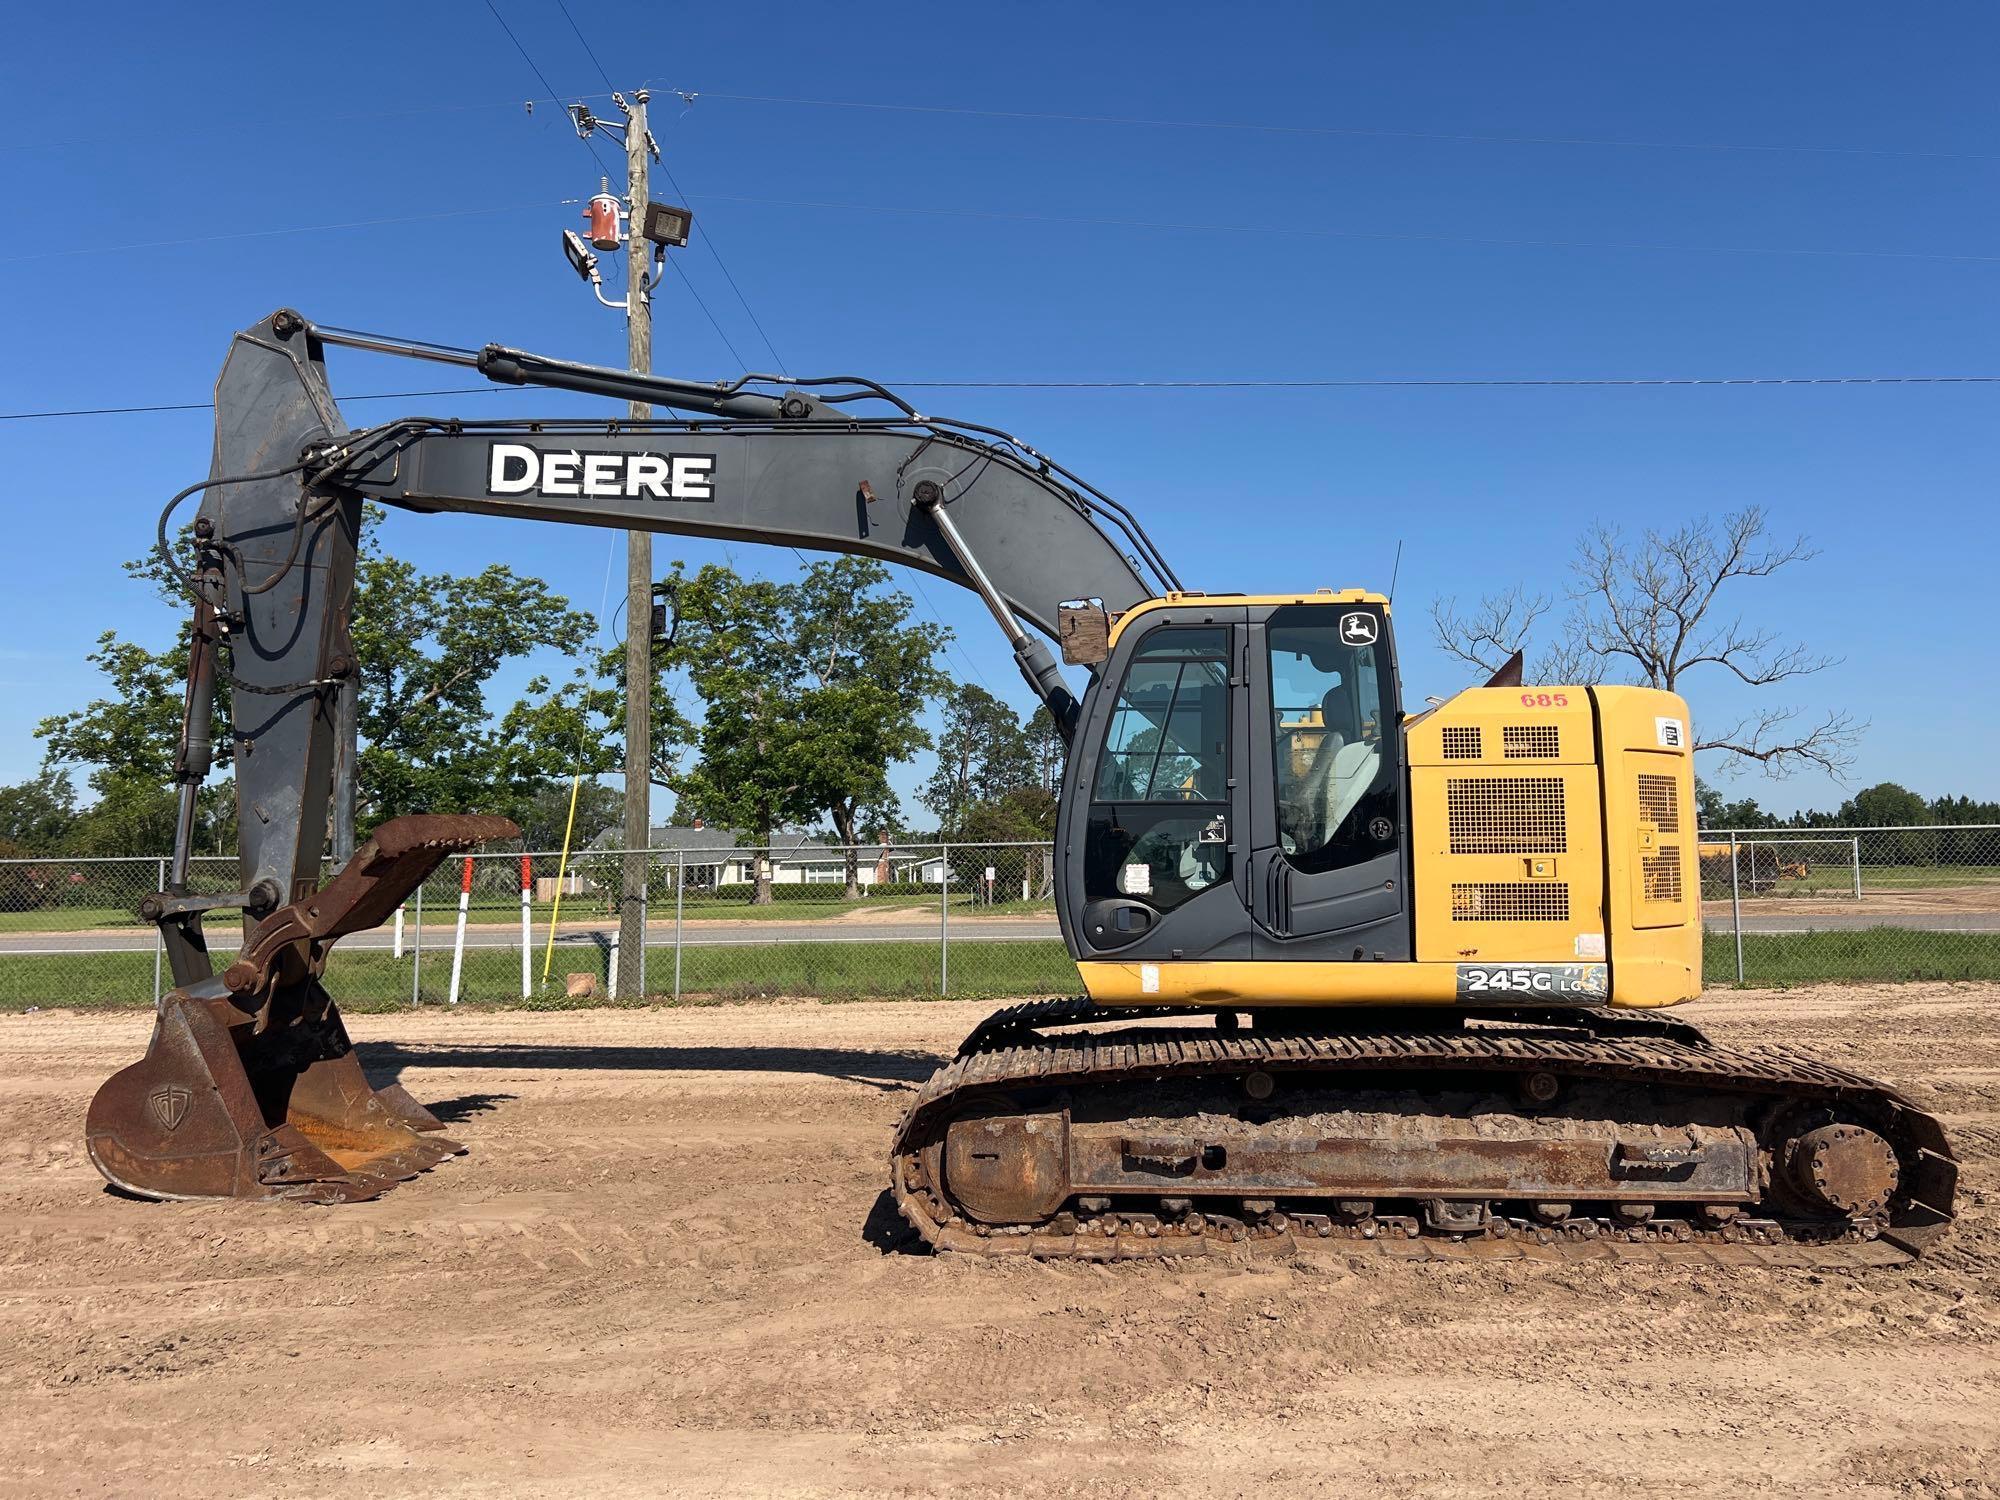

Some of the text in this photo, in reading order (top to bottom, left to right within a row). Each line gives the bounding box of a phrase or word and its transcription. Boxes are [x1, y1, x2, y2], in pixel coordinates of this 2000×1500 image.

[490, 444, 712, 498] DEERE
[1521, 694, 1568, 707] 685
[1468, 970, 1551, 991] 245G
